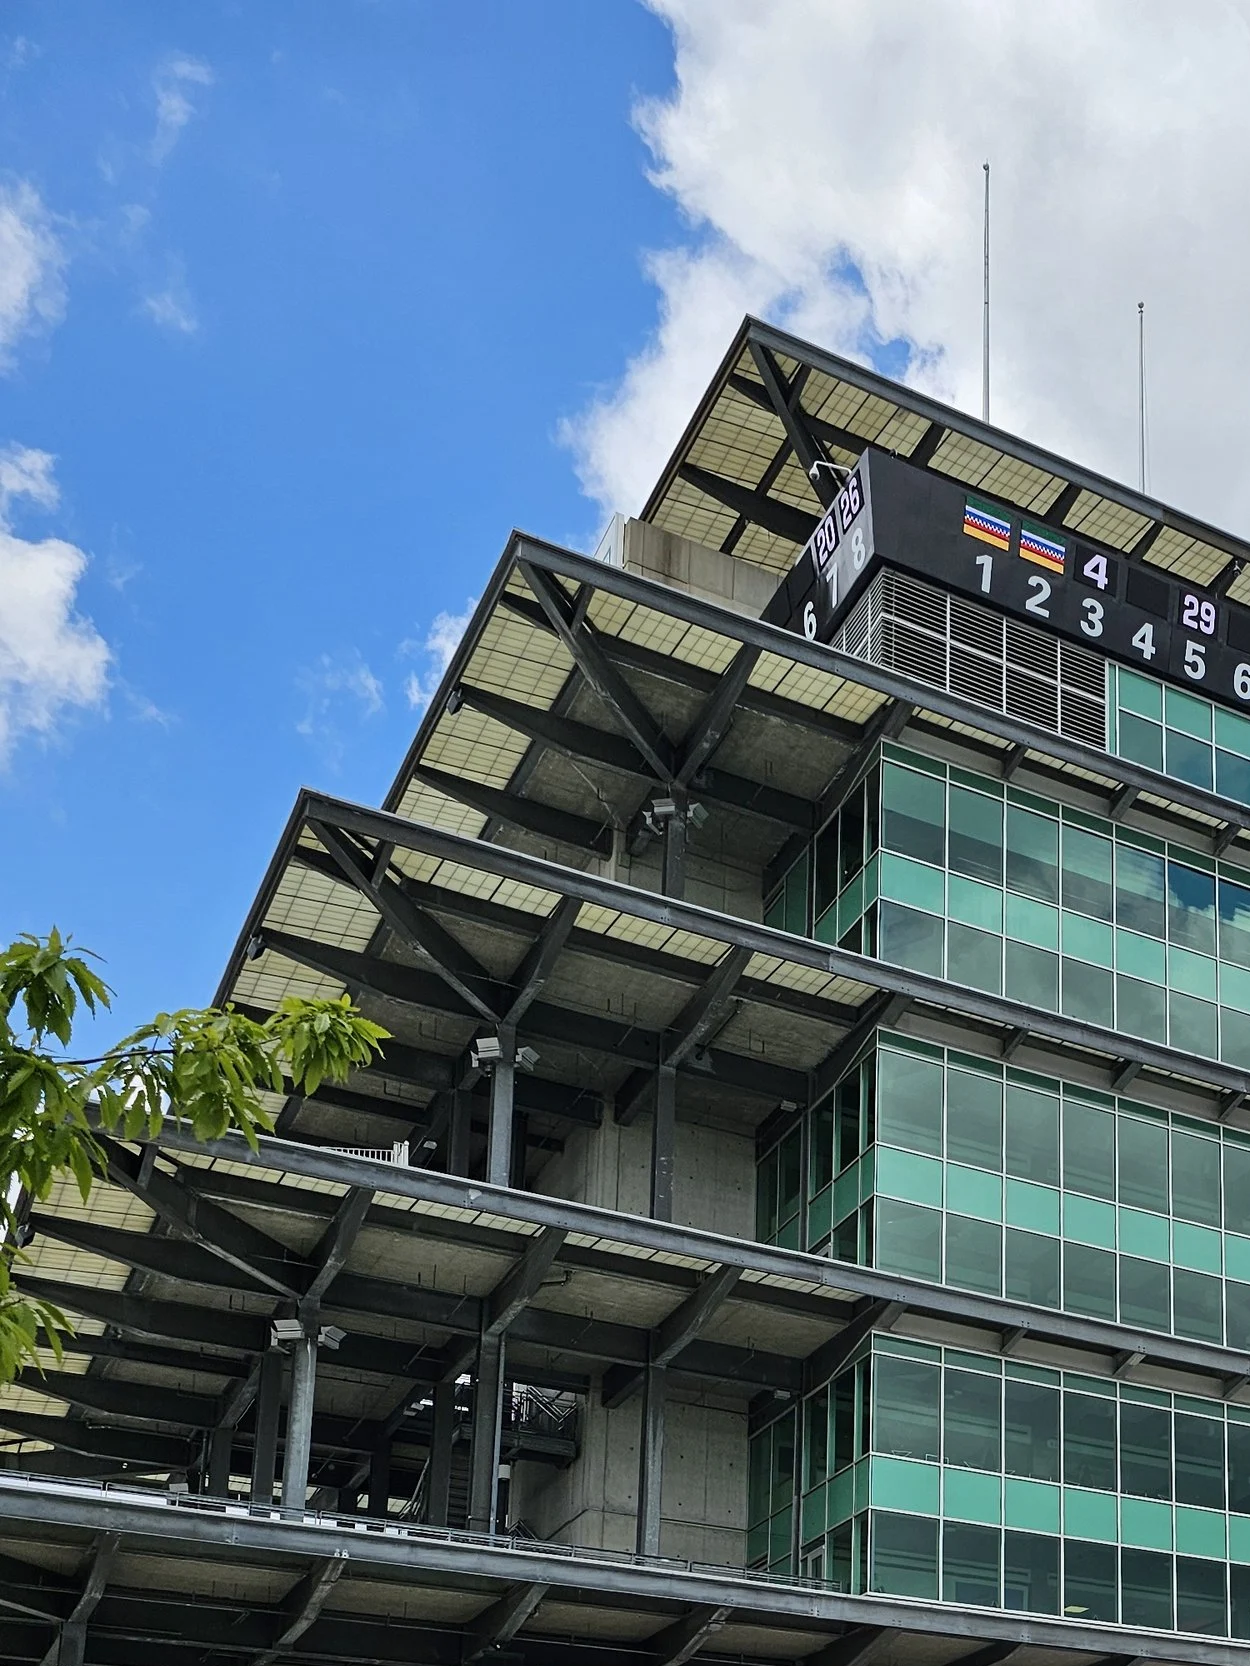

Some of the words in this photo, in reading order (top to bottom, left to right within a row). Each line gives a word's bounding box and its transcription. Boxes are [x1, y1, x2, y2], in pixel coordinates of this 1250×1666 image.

[816, 515, 836, 567] 20
[840, 477, 861, 531] 26
[803, 601, 817, 641] 6
[826, 562, 839, 609] 7
[852, 527, 866, 571] 8
[975, 554, 993, 594] 1
[1025, 575, 1052, 619] 2
[1080, 597, 1105, 638] 3
[1131, 622, 1156, 661] 4
[1183, 639, 1206, 680] 5
[1083, 554, 1109, 591] 4
[1182, 594, 1216, 635] 29
